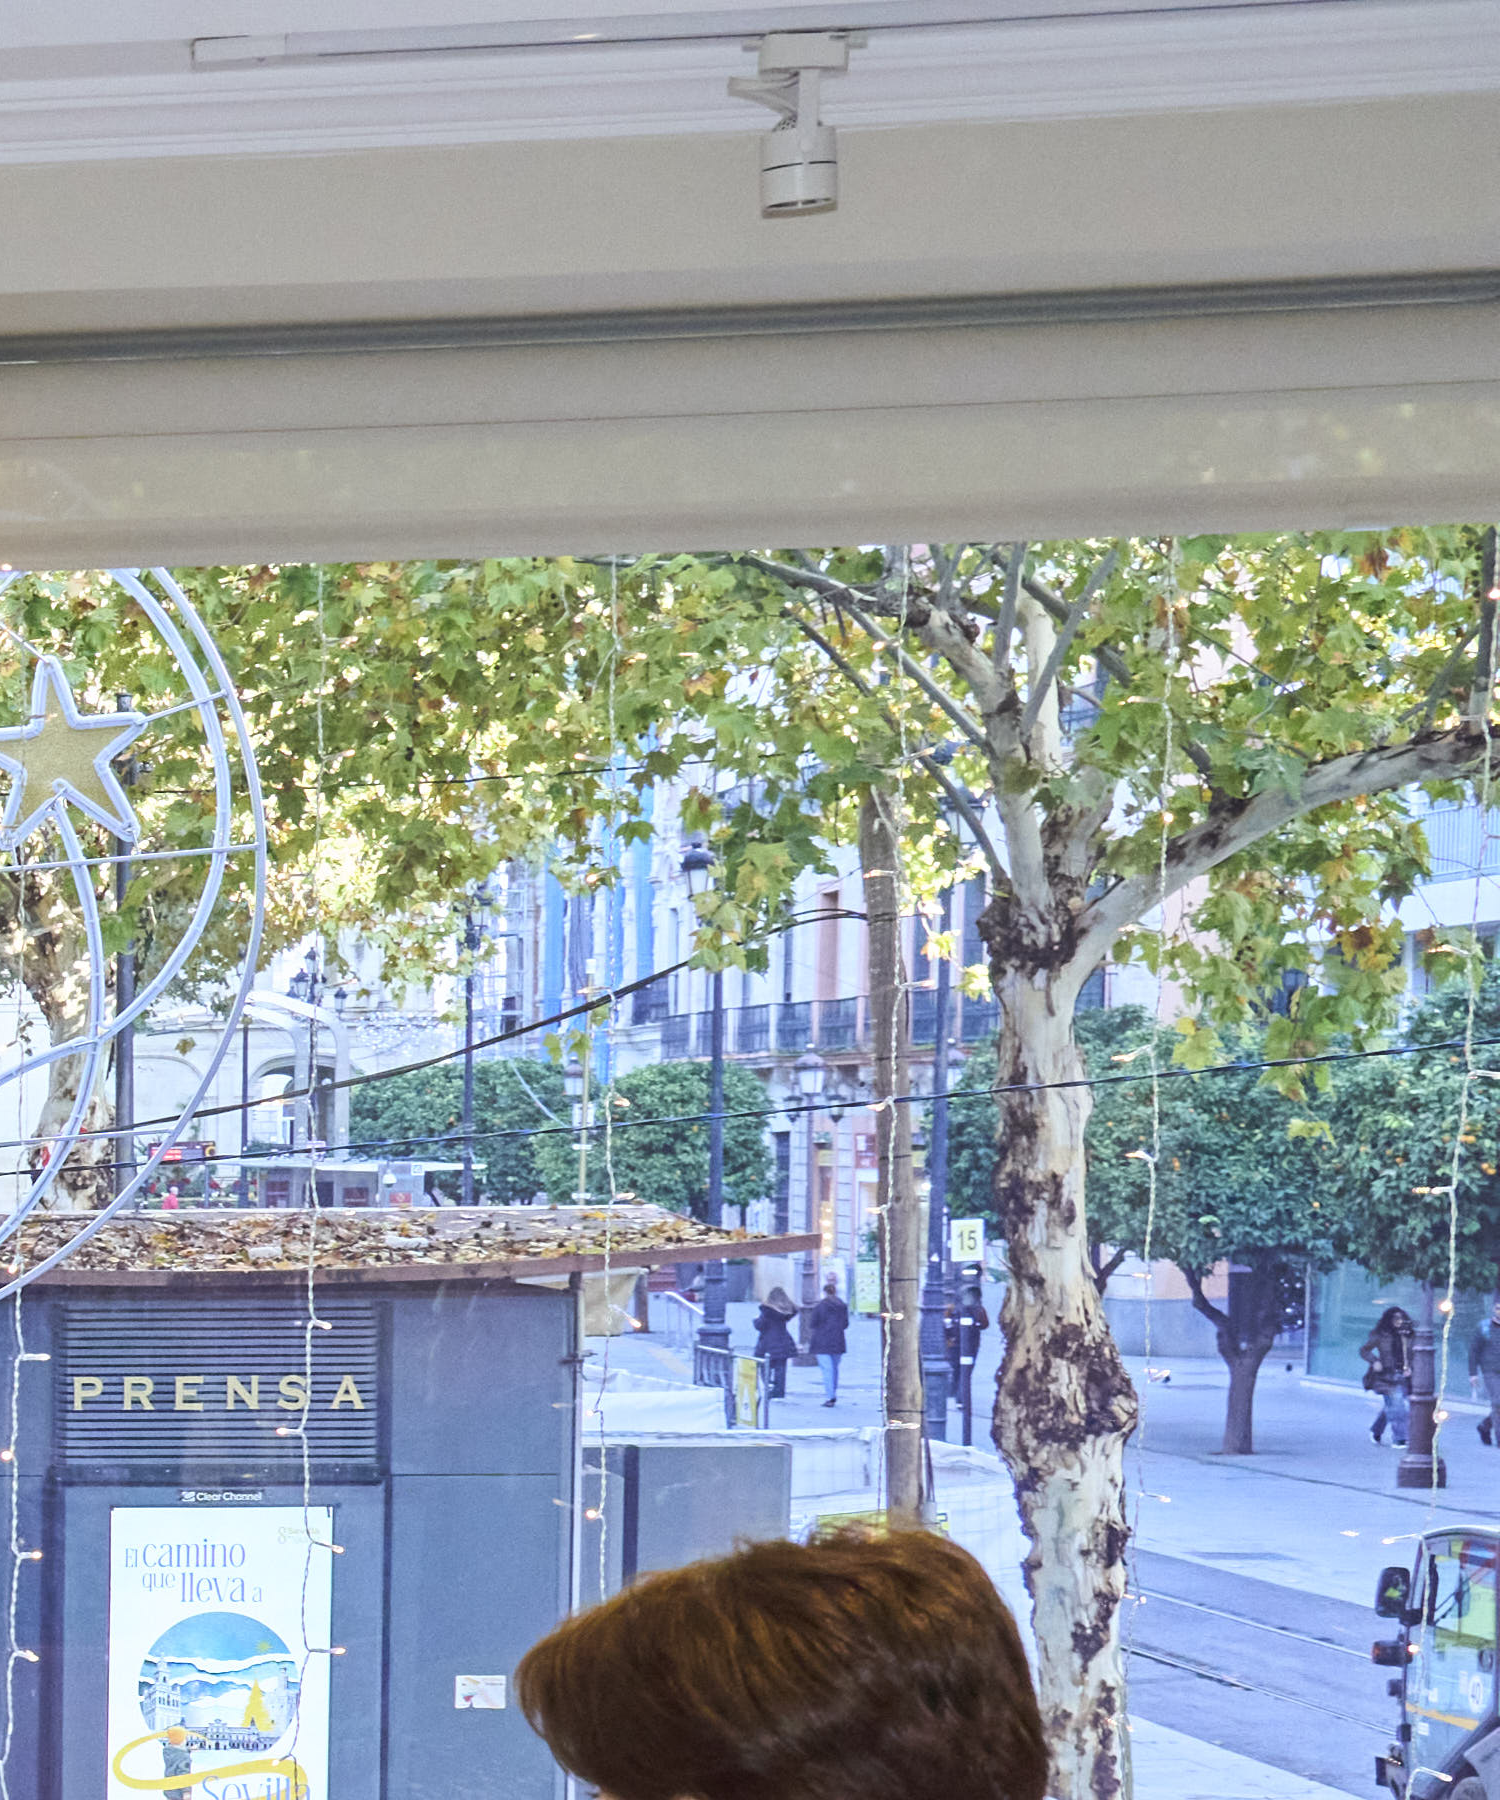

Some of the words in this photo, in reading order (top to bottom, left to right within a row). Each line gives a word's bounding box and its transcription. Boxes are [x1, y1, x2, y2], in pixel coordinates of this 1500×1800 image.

[957, 1229, 977, 1251] 15
[73, 1374, 365, 1412] PRENSA
[195, 1490, 222, 1501] Clear
[222, 1490, 263, 1501] Channel
[125, 1547, 138, 1568] El
[142, 1538, 246, 1568] camino
[142, 1572, 176, 1592] que
[180, 1572, 246, 1603] lleva
[251, 1586, 263, 1603] a
